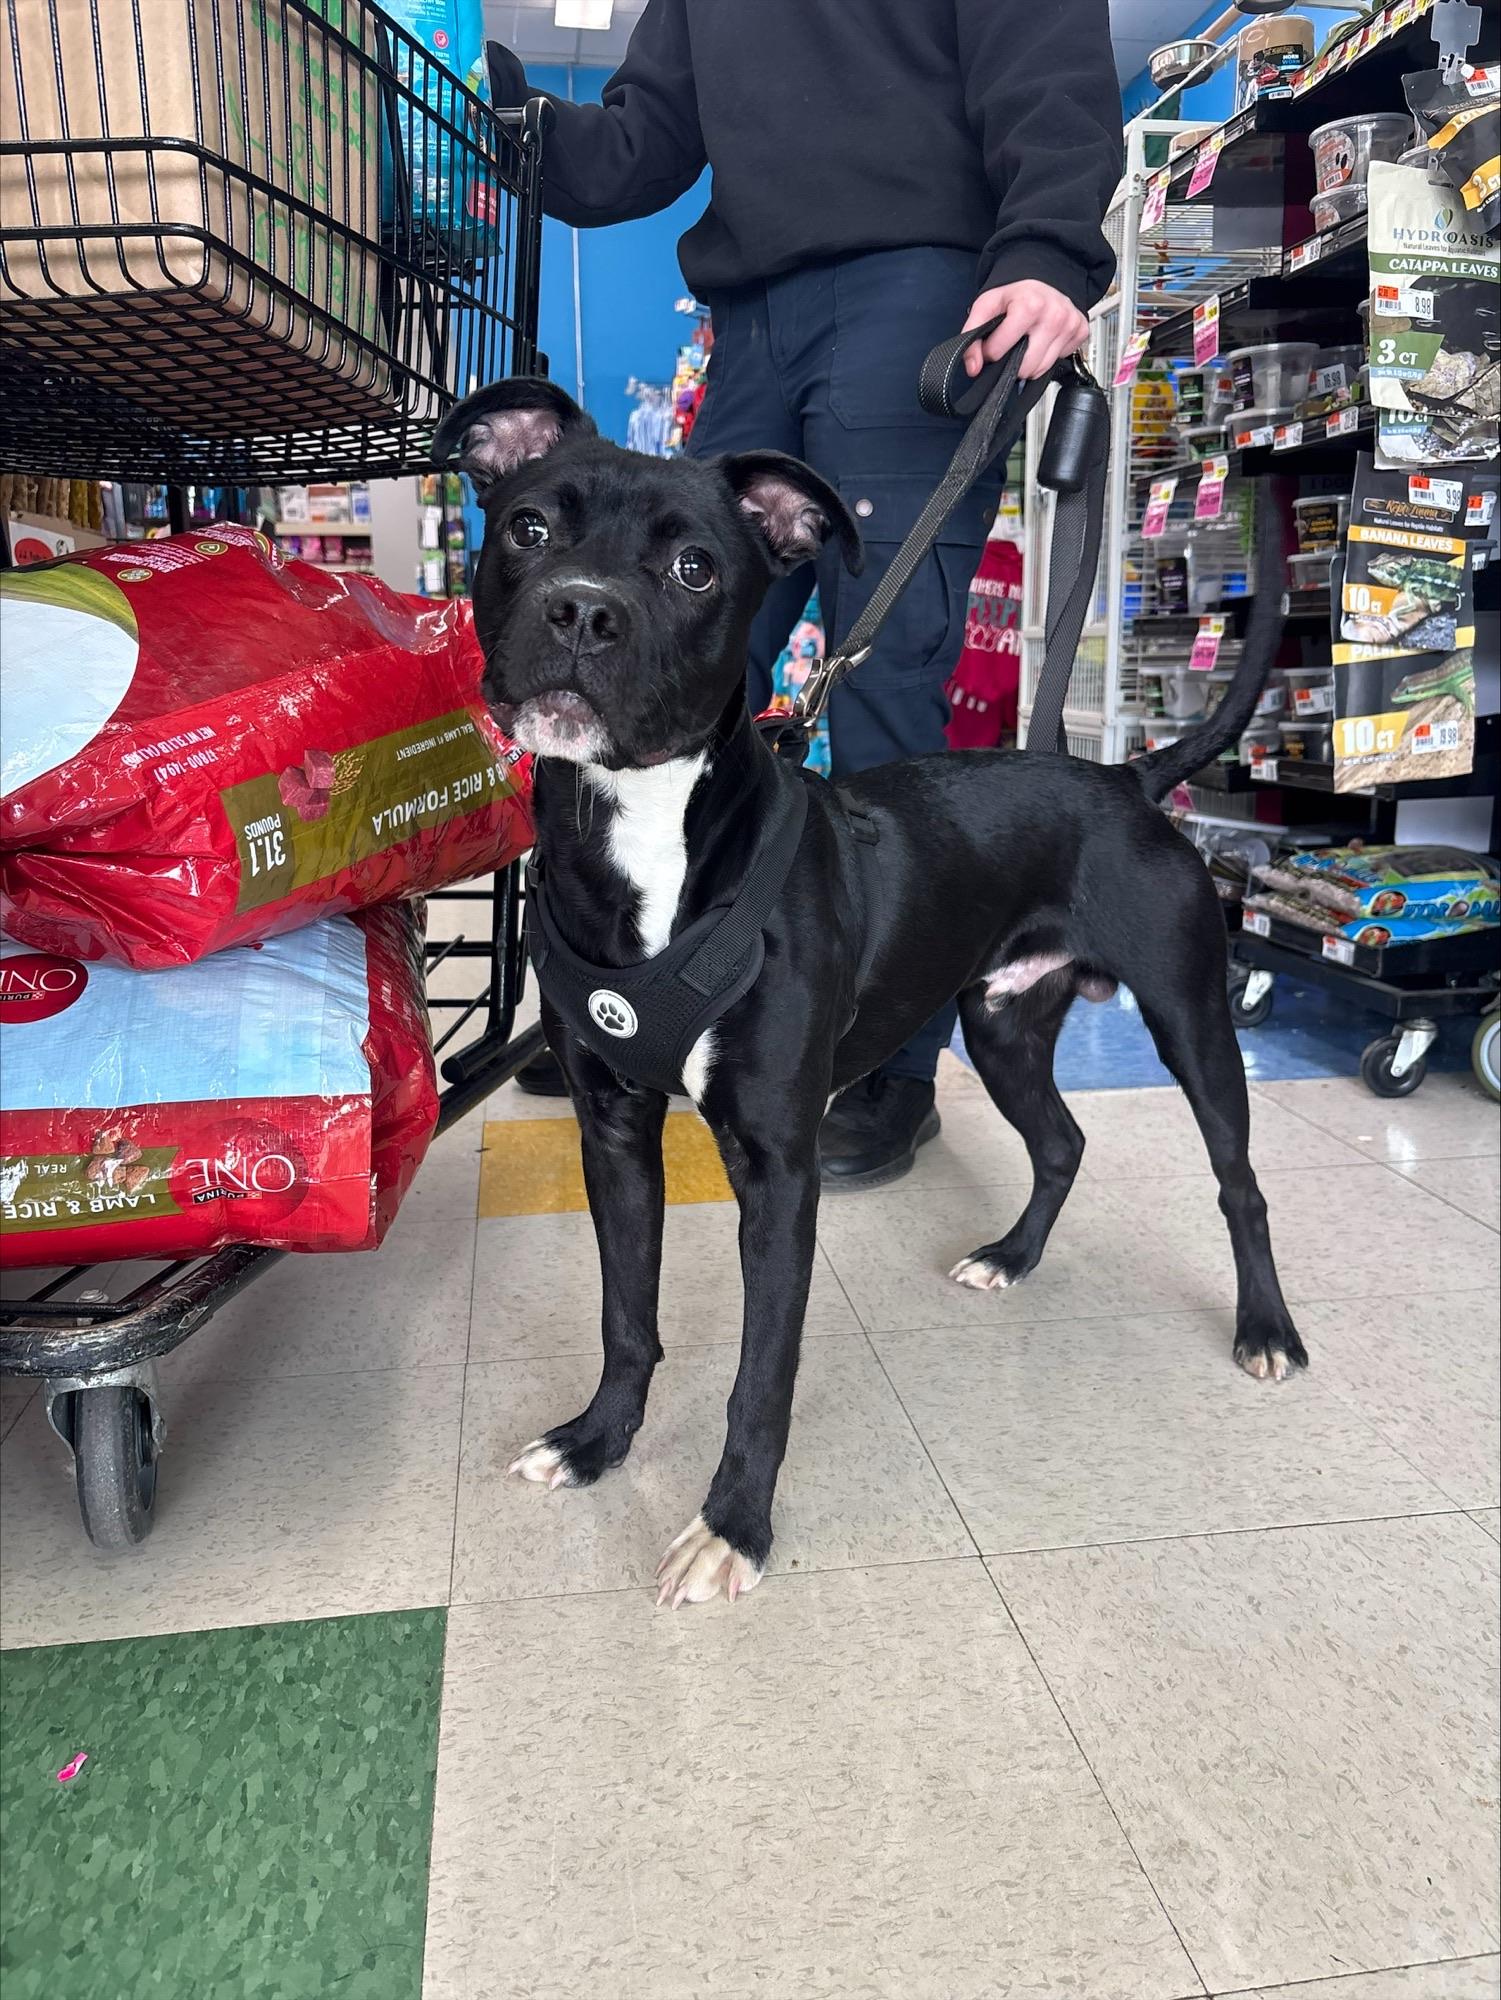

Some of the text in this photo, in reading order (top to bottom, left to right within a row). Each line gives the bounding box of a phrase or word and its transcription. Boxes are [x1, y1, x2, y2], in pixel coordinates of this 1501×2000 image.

[1473, 174, 1487, 199] 3
[1389, 258, 1498, 278] CATAPPA LEAVES
[1415, 296, 1431, 315] 8.98
[1377, 338, 1418, 365] 3 CT
[1360, 528, 1453, 550] BANANA LEAVES
[1350, 587, 1371, 612] 10
[184, 731, 201, 746] WT
[197, 725, 217, 741] NET
[444, 727, 461, 744] LAMB
[459, 722, 475, 738] REAL
[1342, 719, 1396, 753] 10 CT
[156, 741, 173, 754] LB
[396, 738, 437, 762] INGREDIENT
[371, 767, 495, 836] & RICE FORMULA
[244, 812, 282, 842] POUNDS
[249, 830, 286, 877] 31.1
[33, 1163, 68, 1175] REAL
[185, 1153, 296, 1193] ONE
[4, 1193, 156, 1220] LAMB & RICE
[196, 1187, 247, 1203] PURINA
